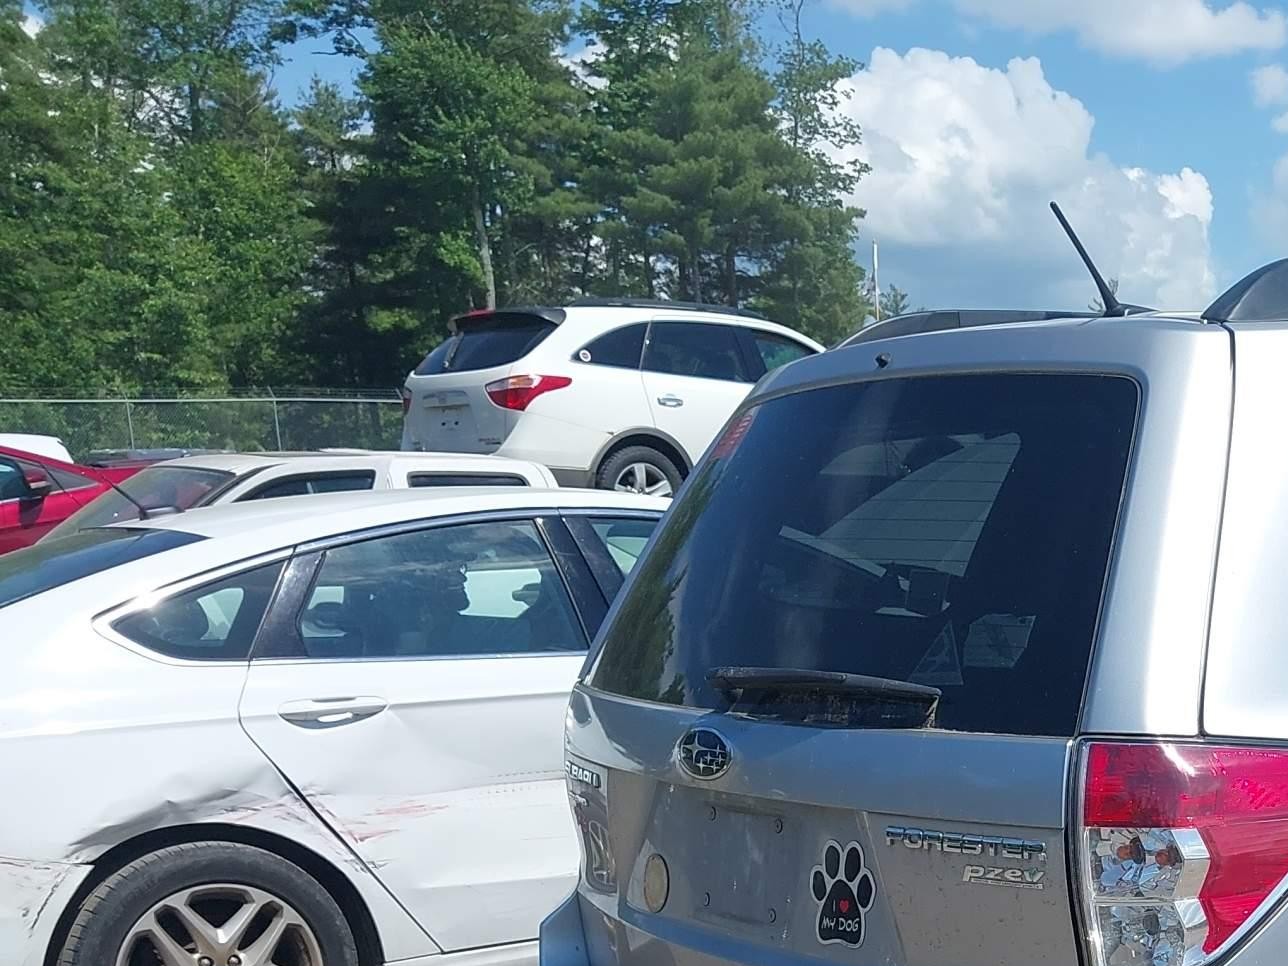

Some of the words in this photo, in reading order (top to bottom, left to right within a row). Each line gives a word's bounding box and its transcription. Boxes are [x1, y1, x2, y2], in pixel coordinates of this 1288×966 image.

[885, 825, 1048, 863] FORESTER
[831, 899, 837, 913] I
[821, 915, 837, 930] MY
[838, 917, 860, 932] DOG
